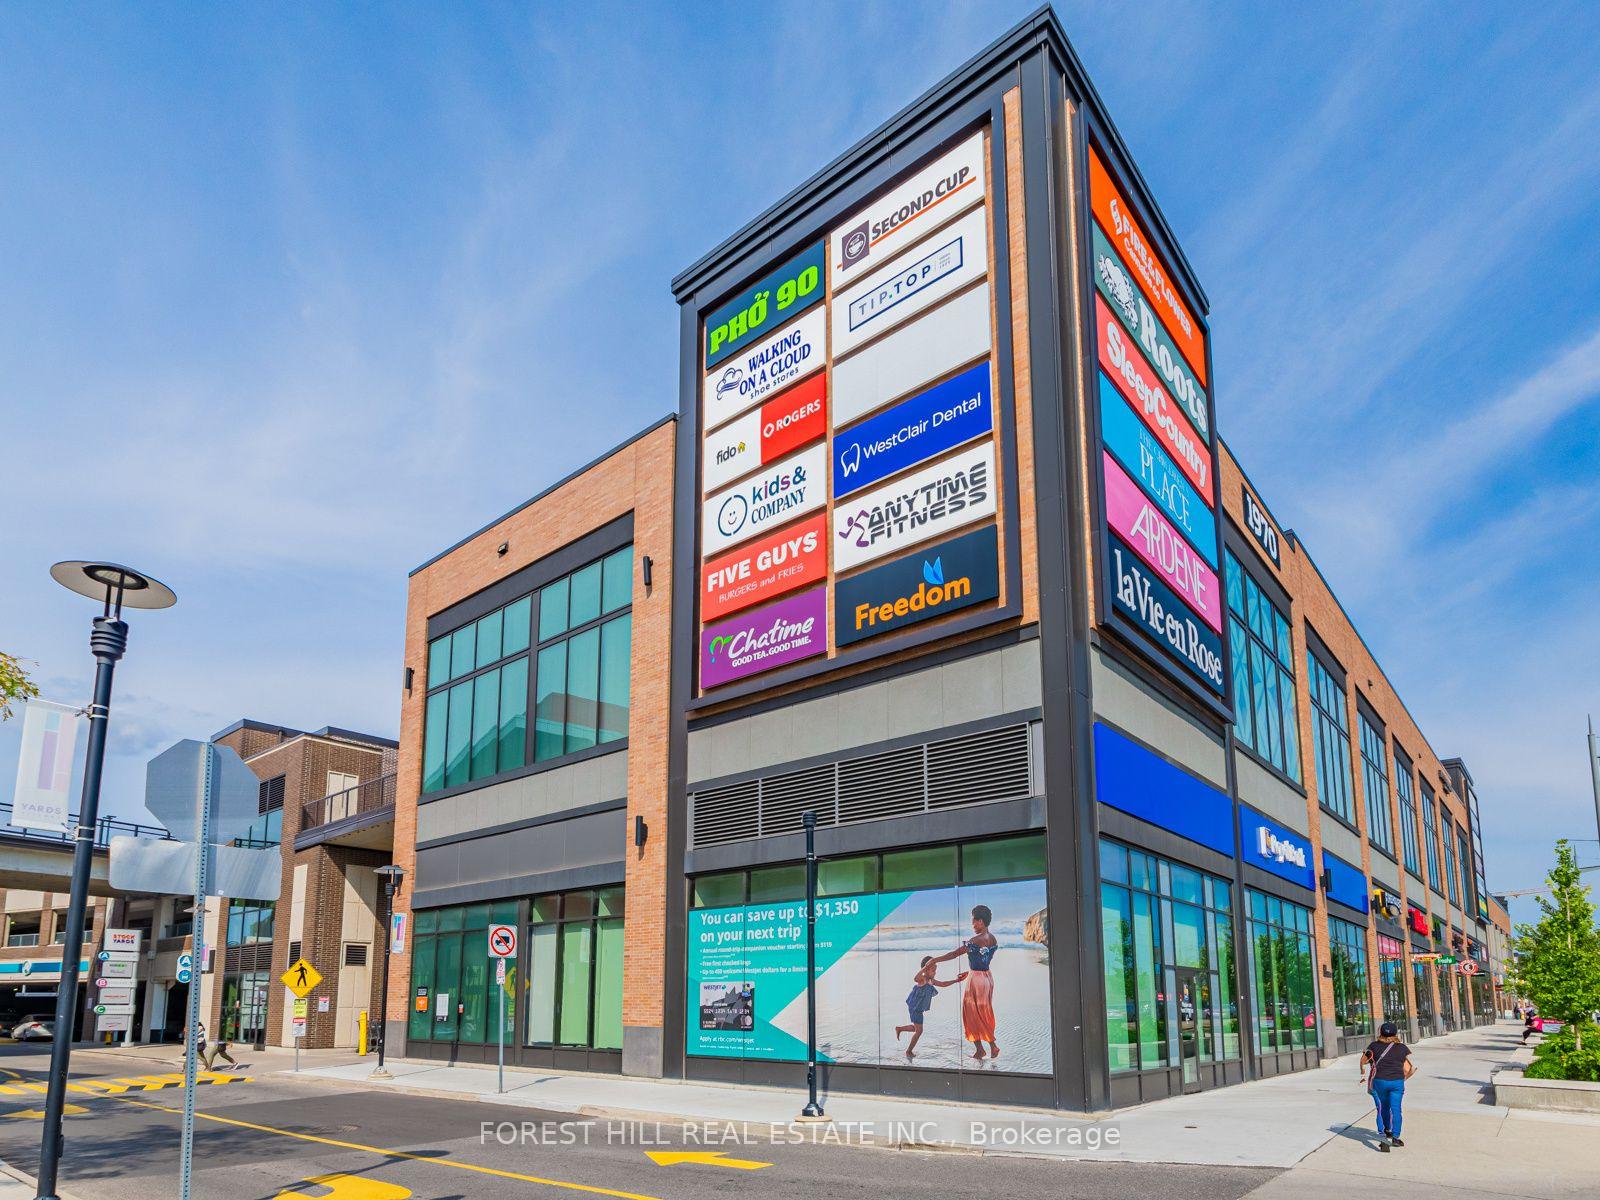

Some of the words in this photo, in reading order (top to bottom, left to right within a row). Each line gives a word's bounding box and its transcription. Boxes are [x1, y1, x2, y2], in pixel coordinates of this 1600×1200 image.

[872, 188, 934, 241] SECOND
[934, 165, 970, 198] CUP
[776, 265, 819, 311] 90
[739, 374, 756, 395] ON
[759, 370, 767, 385] A
[770, 343, 811, 377] CLOUD
[748, 330, 801, 373] WALKING
[1138, 298, 1207, 433] Roots
[750, 381, 771, 400] shoe
[772, 367, 799, 386] stores
[776, 399, 821, 431] ROGERS
[864, 420, 928, 459] WestClair
[933, 392, 981, 427] Dental
[716, 446, 737, 465] fido
[752, 487, 806, 524] COMPANY
[868, 461, 987, 530] ANYTIME
[1140, 442, 1192, 532] PLACE
[870, 488, 988, 545] FITNESS
[1246, 494, 1277, 560] 1970
[707, 558, 751, 592] FIVE
[1130, 504, 1207, 611] ARDENE
[719, 581, 757, 603] BURGERS
[760, 575, 776, 587] and
[778, 563, 804, 580] FRIES
[855, 575, 970, 630] Freedom
[728, 617, 815, 658] Chatime
[732, 655, 753, 667] GOOD
[769, 642, 791, 655] GOOD
[1185, 618, 1223, 685] Rose
[22, 802, 62, 815] YARDS
[701, 913, 720, 925] You
[724, 913, 744, 924] can
[747, 910, 775, 921] save
[778, 908, 795, 923] up
[816, 900, 859, 918] $1,350
[701, 931, 715, 943] on
[717, 930, 744, 945] your
[747, 927, 774, 940] next
